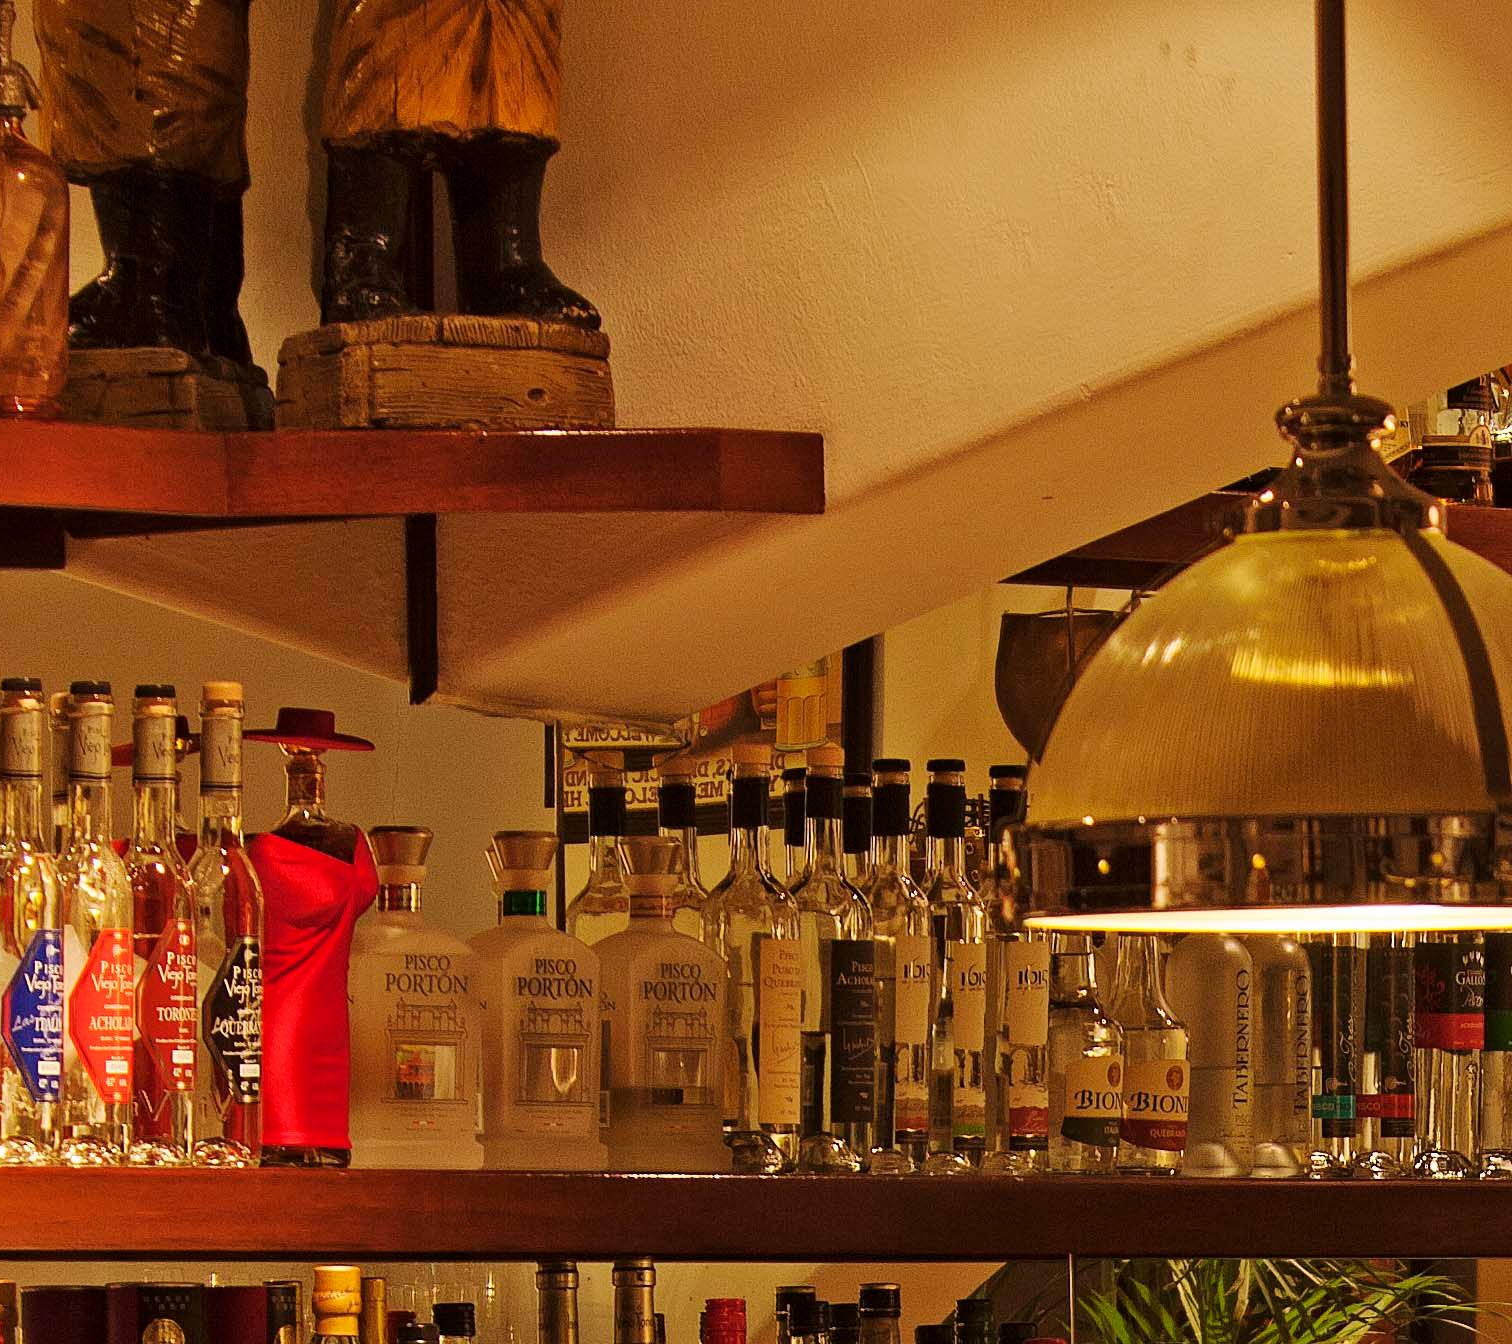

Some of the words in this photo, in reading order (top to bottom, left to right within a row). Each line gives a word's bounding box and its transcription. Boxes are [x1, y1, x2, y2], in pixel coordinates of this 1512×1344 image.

[404, 955, 451, 971] PISCO
[534, 959, 577, 975] PISCO
[660, 963, 701, 980] PISCO
[385, 972, 469, 997] PORTÓN
[517, 975, 593, 1000] PORTÓN
[643, 980, 717, 1003] PORTÓN
[1233, 969, 1250, 1110] TABERNERO
